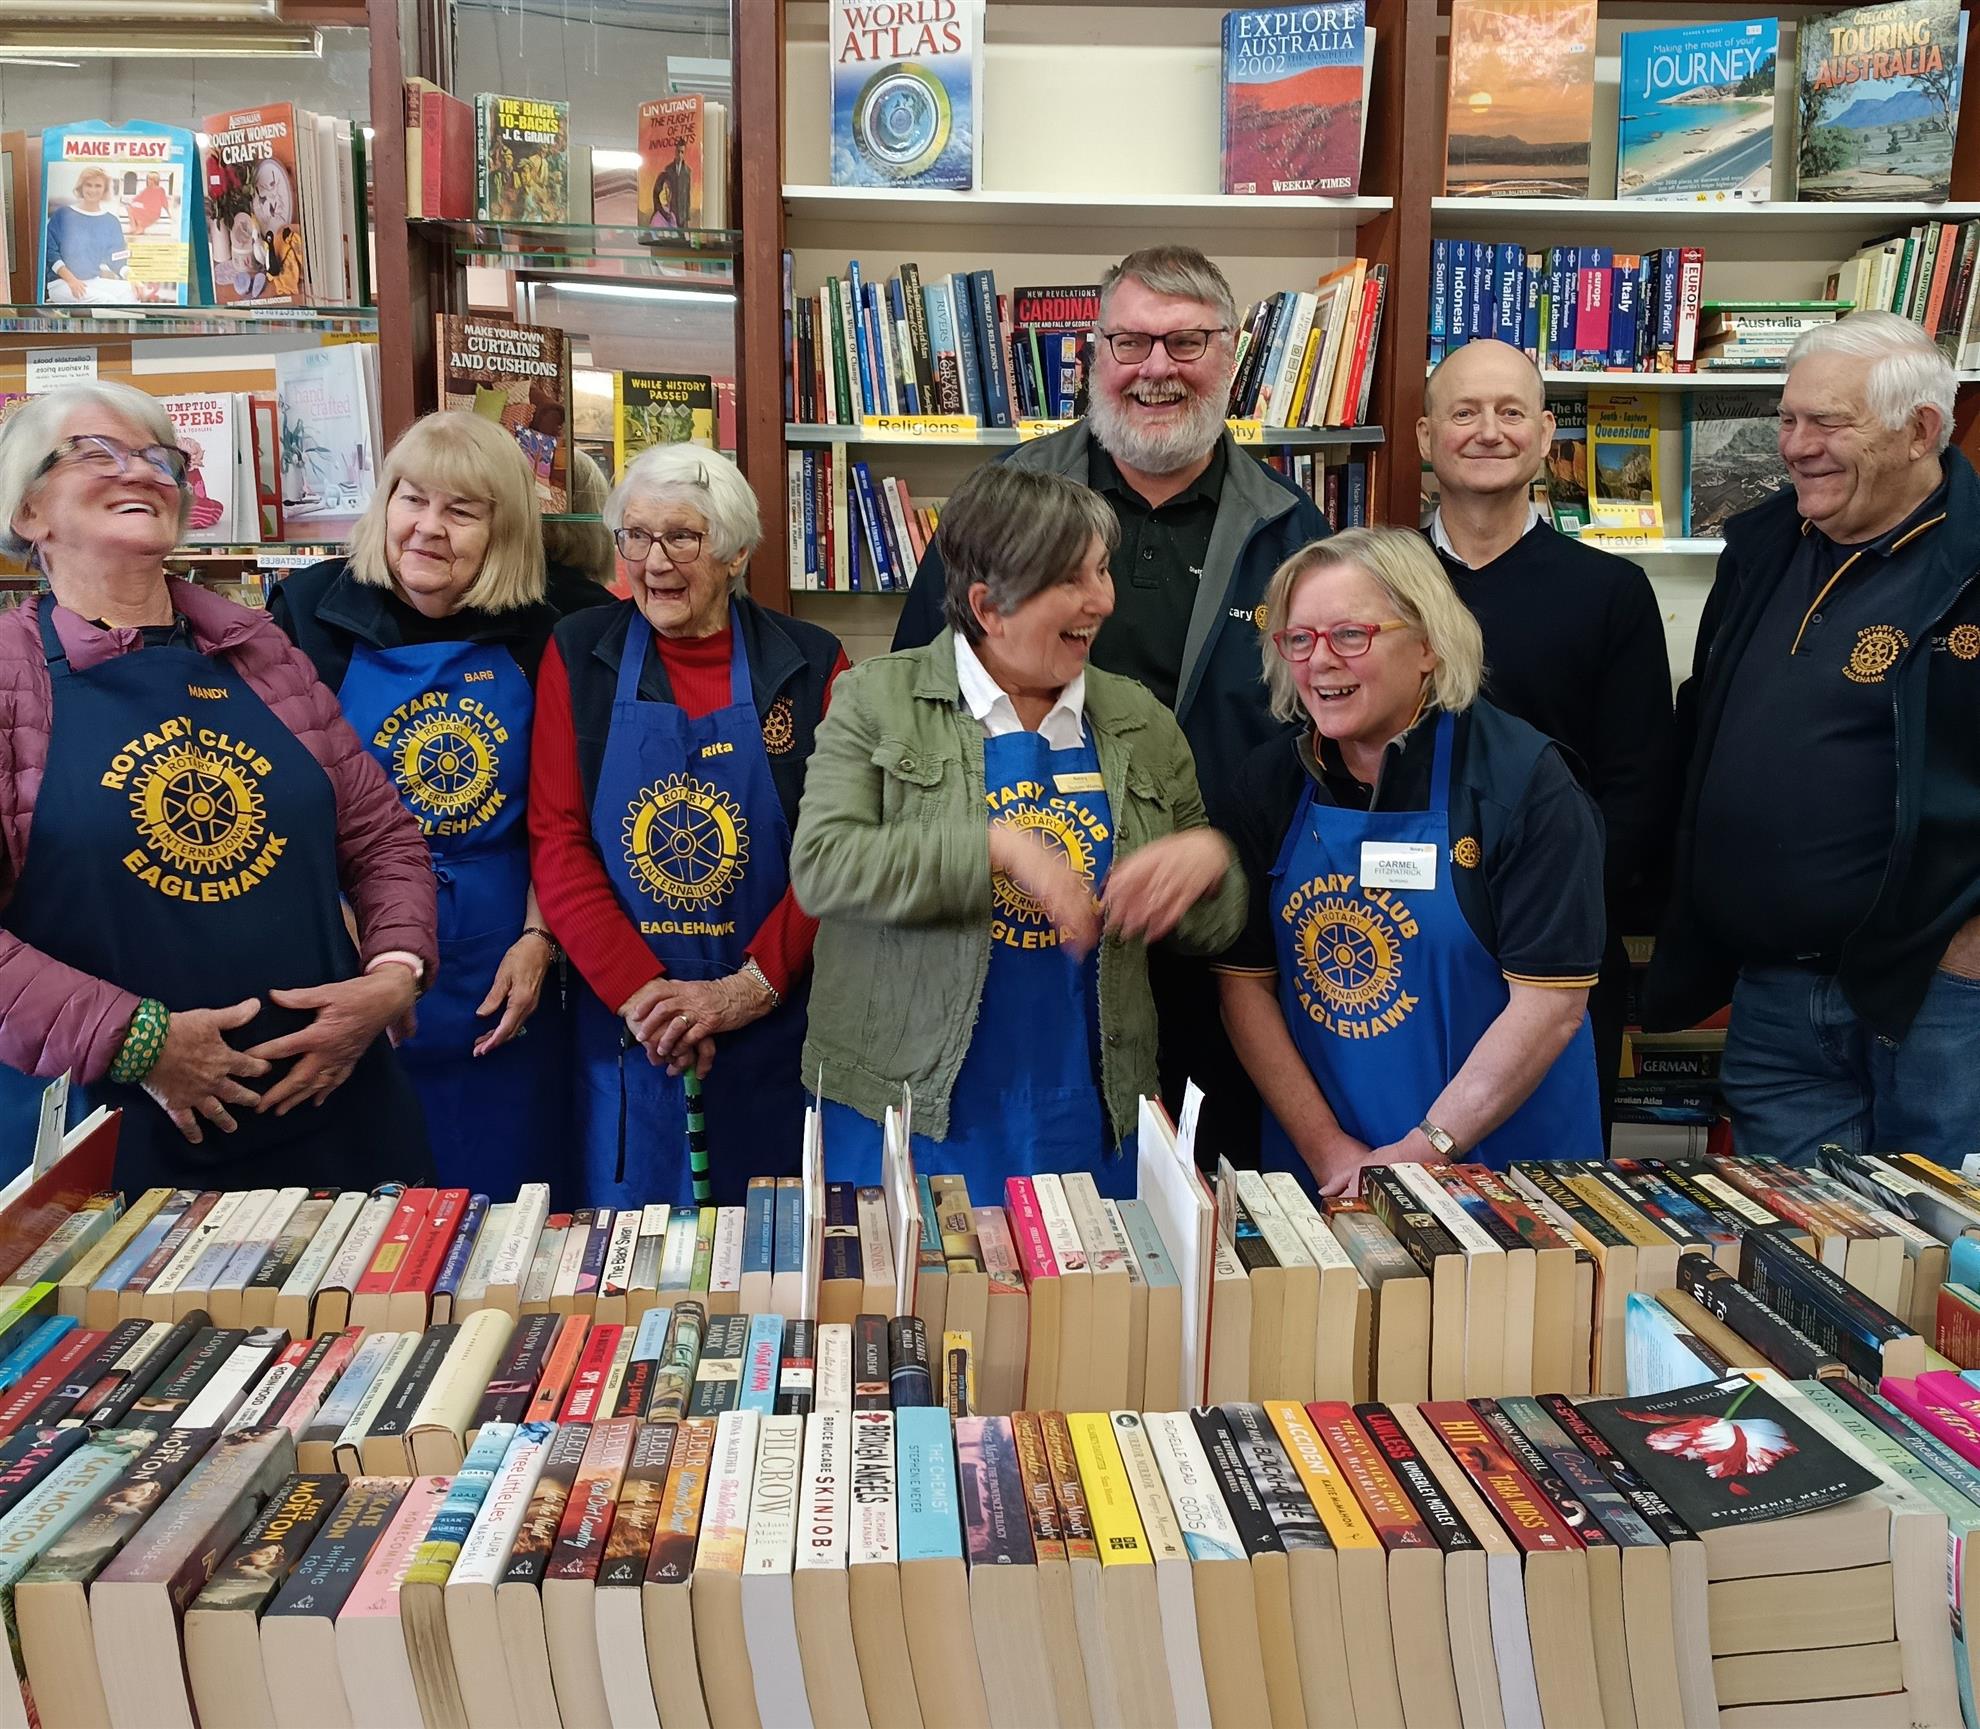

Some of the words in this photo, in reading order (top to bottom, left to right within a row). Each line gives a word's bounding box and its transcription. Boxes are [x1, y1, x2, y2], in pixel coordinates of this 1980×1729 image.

[843, 0, 956, 30] WORLD
[1238, 7, 1356, 39] EXPLORE
[1854, 6, 1908, 26] GREGORY'S
[839, 21, 961, 62] ATLAS
[1238, 32, 1355, 58] AUSTRALIA
[1653, 43, 1682, 55] Making
[1684, 42, 1700, 51] the
[1701, 39, 1723, 50] most
[1725, 37, 1735, 47] of
[1736, 37, 1756, 48] your
[1829, 18, 1931, 58] TOURING
[1238, 56, 1285, 76] 2002
[1643, 47, 1761, 99] JOURNEY
[1814, 45, 1944, 91] AUSTRALIA
[498, 99, 520, 115] THE
[521, 101, 559, 119] BACK-
[642, 103, 658, 117] LIN
[659, 98, 697, 113] YUTANG
[666, 111, 695, 127] FLIGHT
[247, 122, 287, 141] WOMEN'S
[499, 114, 559, 132] TO-BACKS
[667, 125, 679, 136] OF
[680, 123, 695, 135] THE
[65, 140, 111, 157] MAKE
[113, 139, 128, 155] IT
[129, 142, 167, 158] EASY
[222, 140, 273, 165] CRAFTS
[524, 132, 556, 145] GRANT
[1273, 178, 1314, 192] WEEKLY
[1321, 177, 1351, 190] TIMES
[1027, 290, 1043, 298] NEW
[1046, 289, 1096, 298] REVELATIONS
[1436, 263, 1445, 298] South
[1484, 268, 1493, 290] Peru
[1551, 271, 1561, 294] Syria
[1593, 271, 1602, 308] europe
[1664, 273, 1673, 301] South
[1685, 266, 1698, 320] EUROPE
[1919, 261, 1931, 299] CAMPING
[1453, 266, 1466, 335] Indonesia
[1501, 269, 1514, 327] Thailand
[1528, 281, 1538, 309] Cuba
[1618, 281, 1632, 313] Italy
[937, 299, 948, 342] RIVERS
[981, 276, 989, 292] THE
[988, 329, 999, 371] RELIGIONS
[1434, 300, 1444, 332] Pacific
[1550, 303, 1560, 342] Lebanon
[1662, 304, 1671, 335] Pacific
[1737, 316, 1801, 328] Australia
[464, 324, 492, 337] MAKE
[491, 327, 520, 340] YOUR
[520, 331, 545, 344] OWN
[468, 337, 540, 359] CURTAINS
[451, 351, 483, 371] AND
[487, 355, 558, 378] CUSHIONS
[631, 379, 662, 391] WHILE
[666, 381, 706, 393] HISTORY
[649, 390, 689, 402] PASSED
[939, 359, 951, 410] GRACE
[1552, 403, 1573, 414] The
[879, 420, 959, 437] Religions
[1595, 424, 1650, 440] Queensland
[1595, 533, 1648, 546] Travel
[1857, 625, 1895, 638] ROTARY
[464, 670, 494, 682] BARB
[1841, 666, 1885, 683] EAGLEHAWK
[188, 684, 229, 700] MANDY
[373, 691, 449, 749] ROTARY
[459, 697, 509, 744] CLUB
[424, 724, 465, 736] ROTARY
[101, 716, 191, 790] ROTARY
[198, 728, 273, 777] CLUB
[702, 741, 733, 758] Rita
[168, 757, 213, 773] ROTARY
[413, 775, 486, 804] INTERNATIONAL
[663, 789, 706, 805] ROTARY
[1014, 816, 1060, 829] ROTARY
[1049, 797, 1109, 842] CLUB
[160, 820, 249, 858] INTERNATIONAL
[122, 831, 288, 902] EAGLEHAWK
[641, 857, 731, 896] INTERNATIONAL
[1374, 868, 1422, 876] FITZPATRICK
[1379, 860, 1418, 869] CARMEL
[1281, 874, 1355, 924] ROTARY
[1363, 888, 1420, 939] CLUB
[1322, 911, 1364, 926] ROTARY
[640, 921, 735, 936] EAGLEHAWK
[1313, 966, 1386, 1001] INTERNATIONAL
[1643, 1060, 1698, 1073] GERMAN
[1527, 1167, 1582, 1210] WINNING
[608, 1262, 619, 1281] The
[622, 1226, 633, 1244] Swan
[96, 1321, 146, 1363] FROSTBITE
[199, 1331, 229, 1358] BLOOD
[523, 1315, 547, 1350] SHADOW
[706, 1324, 725, 1349] MARX
[724, 1317, 746, 1357] ELEANOR
[902, 1329, 914, 1349] CHILD
[513, 1350, 532, 1372] KISS
[864, 1342, 879, 1376] ACADEMY
[165, 1358, 203, 1397] PROMISE
[1279, 1407, 1297, 1424] THE
[1646, 1399, 1678, 1412] new
[1805, 1387, 1845, 1417] kiss
[1844, 1420, 1876, 1442] me
[822, 1416, 834, 1440] BRUCE
[857, 1424, 891, 1461] BROKEN
[1440, 1420, 1490, 1443] HIT
[1491, 1412, 1516, 1436] SUSAN
[1511, 1433, 1548, 1471] MITCHELL
[129, 1430, 194, 1481] MORTON
[167, 1444, 192, 1464] KATE
[566, 1426, 587, 1465] FLEUR
[605, 1423, 629, 1466] FLEUR
[646, 1428, 671, 1467] FLEUR
[689, 1427, 712, 1468] FLEUR
[820, 1442, 833, 1473] McCABE
[928, 1443, 945, 1464] THE
[1286, 1422, 1333, 1477] ACCIDENT
[1906, 1436, 1967, 1481] Pheasants
[73, 1457, 115, 1488] KATE
[460, 1469, 491, 1477] COAST
[510, 1445, 539, 1475] Three
[756, 1427, 798, 1518] PILCROW
[908, 1445, 921, 1485] STEPHENIE
[1179, 1459, 1197, 1486] MEAD
[1328, 1426, 1351, 1455] FIONA
[1349, 1455, 1391, 1514] McFARLANE
[1366, 1413, 1416, 1461] LAWLESS
[1401, 1461, 1430, 1496] KIMBERLEY
[1426, 1495, 1458, 1527] MOTLEY
[853, 1463, 895, 1505] ANGELS
[930, 1467, 948, 1515] CHEMIST
[1321, 1479, 1338, 1498] KATIE
[261, 1480, 321, 1542] MORTON
[302, 1499, 324, 1522] KATE
[358, 1496, 390, 1527] KATE
[811, 1476, 835, 1547] SKINJOB
[910, 1486, 922, 1513] MEYER
[1179, 1496, 1206, 1530] GODS
[1487, 1475, 1519, 1496] TARA
[1505, 1497, 1549, 1529] MOSS
[1711, 1498, 1794, 1518] STEPHENIE
[1800, 1482, 1847, 1500] MEYER
[0, 1490, 79, 1554] MORTON
[755, 1520, 788, 1528] Adam
[863, 1506, 873, 1549] MONTANARI
[876, 1511, 887, 1544] RICHARD
[460, 1523, 485, 1569] MARSHALL
[487, 1531, 499, 1558] LAURA
[300, 1555, 321, 1575] FOG
[310, 1545, 346, 1585] SHIFTING
